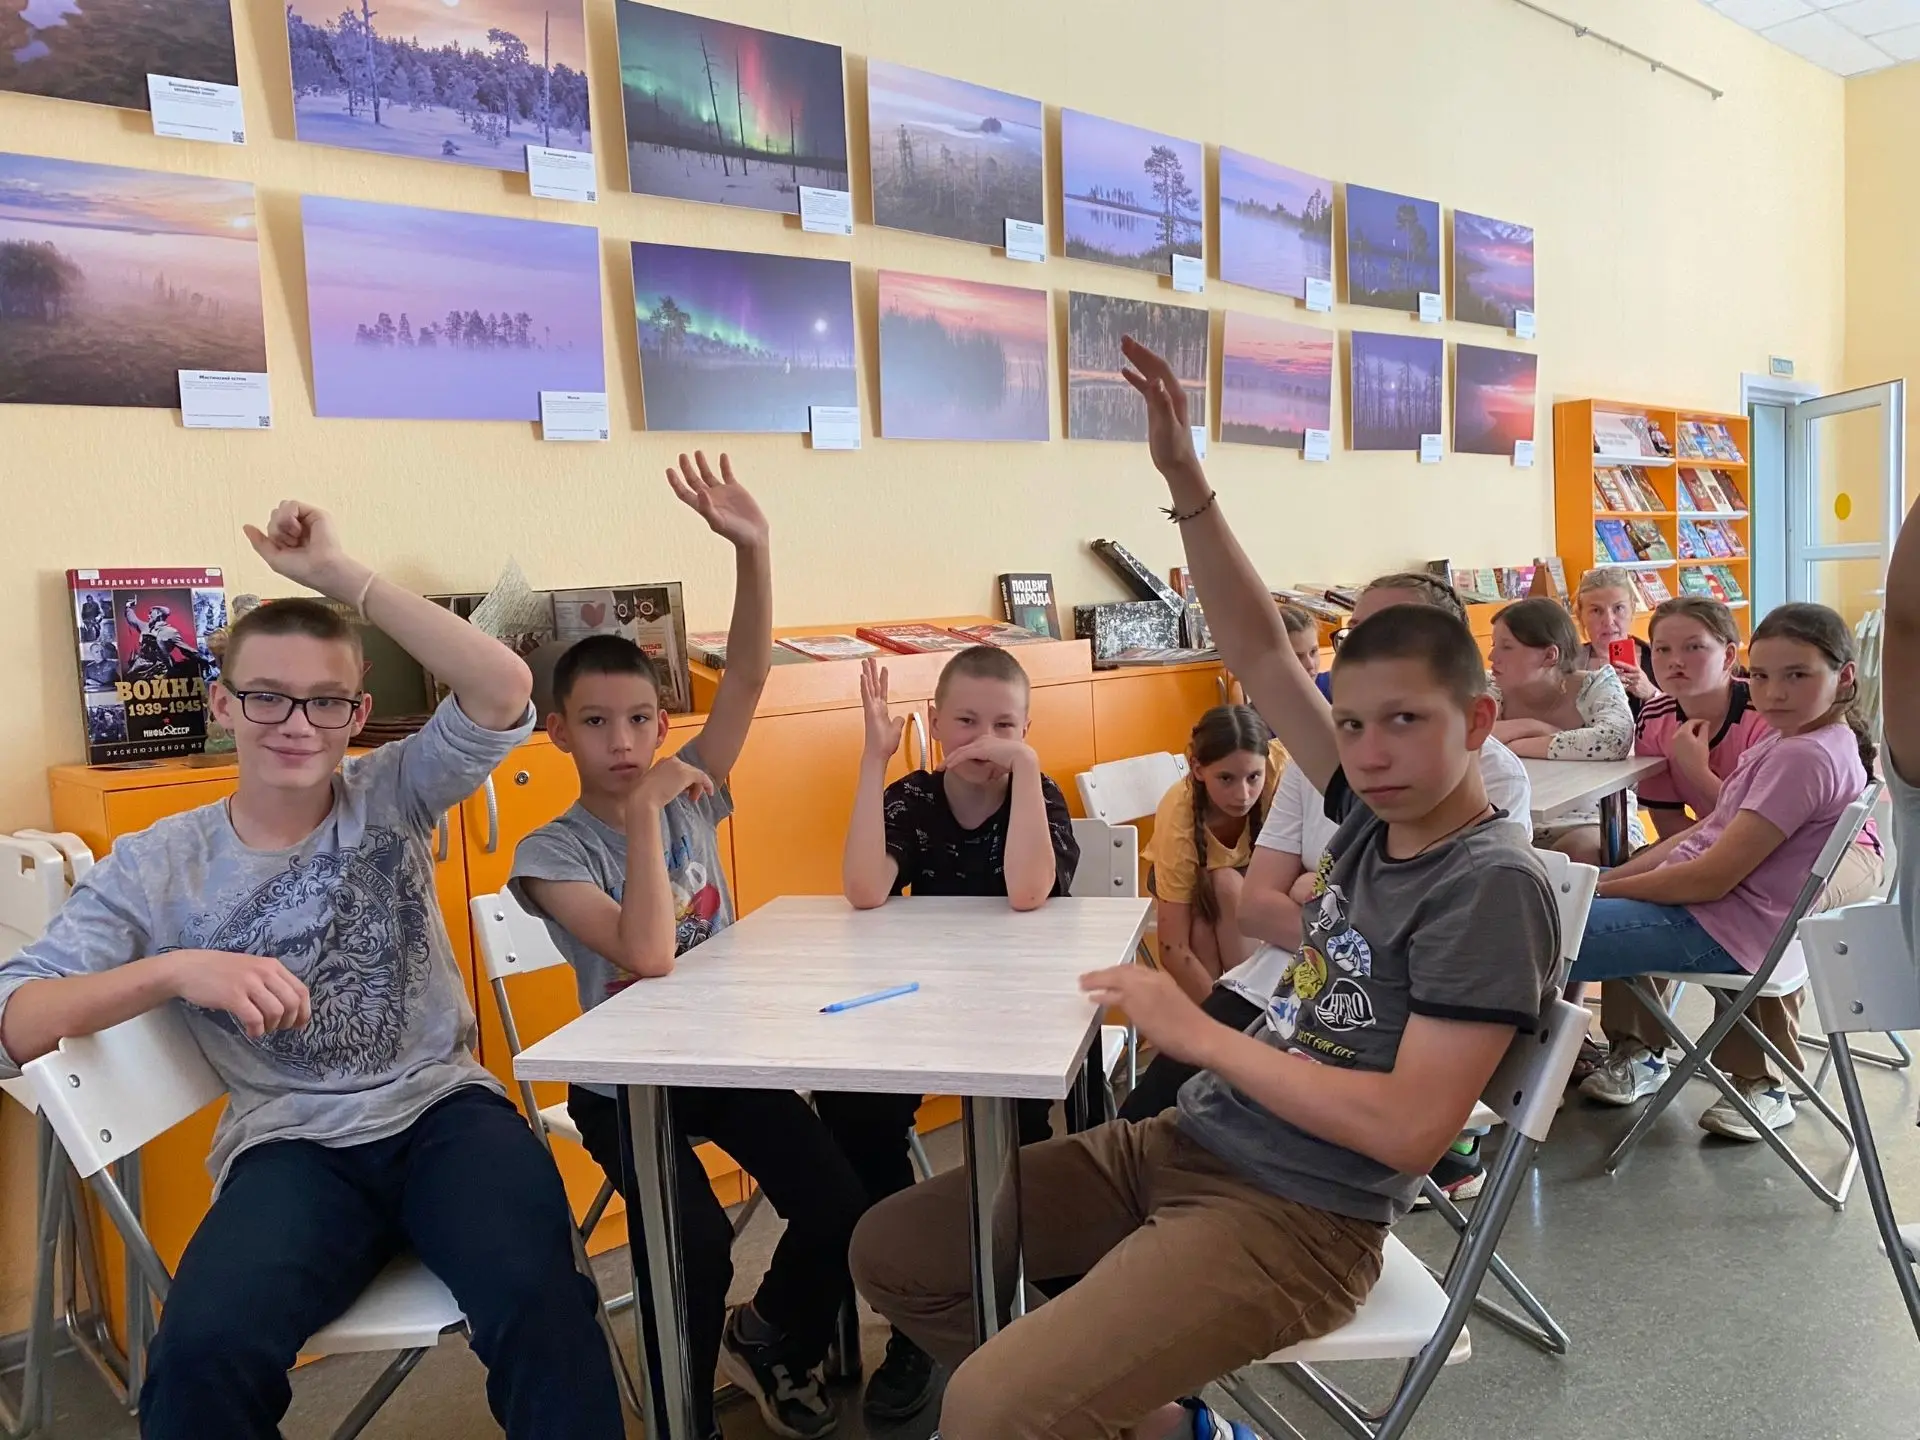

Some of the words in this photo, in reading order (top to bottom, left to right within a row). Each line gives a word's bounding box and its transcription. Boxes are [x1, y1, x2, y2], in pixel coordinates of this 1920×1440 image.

[90, 579, 145, 587] Владимир
[151, 577, 209, 585] Мединский
[1011, 580, 1048, 593] ПОДВИГ
[1013, 592, 1052, 606] НАРОДА
[115, 675, 206, 701] ВОЙНА
[128, 700, 201, 717] 1939-1945
[1328, 992, 1364, 1019] HERO
[1312, 1037, 1335, 1053] FOR
